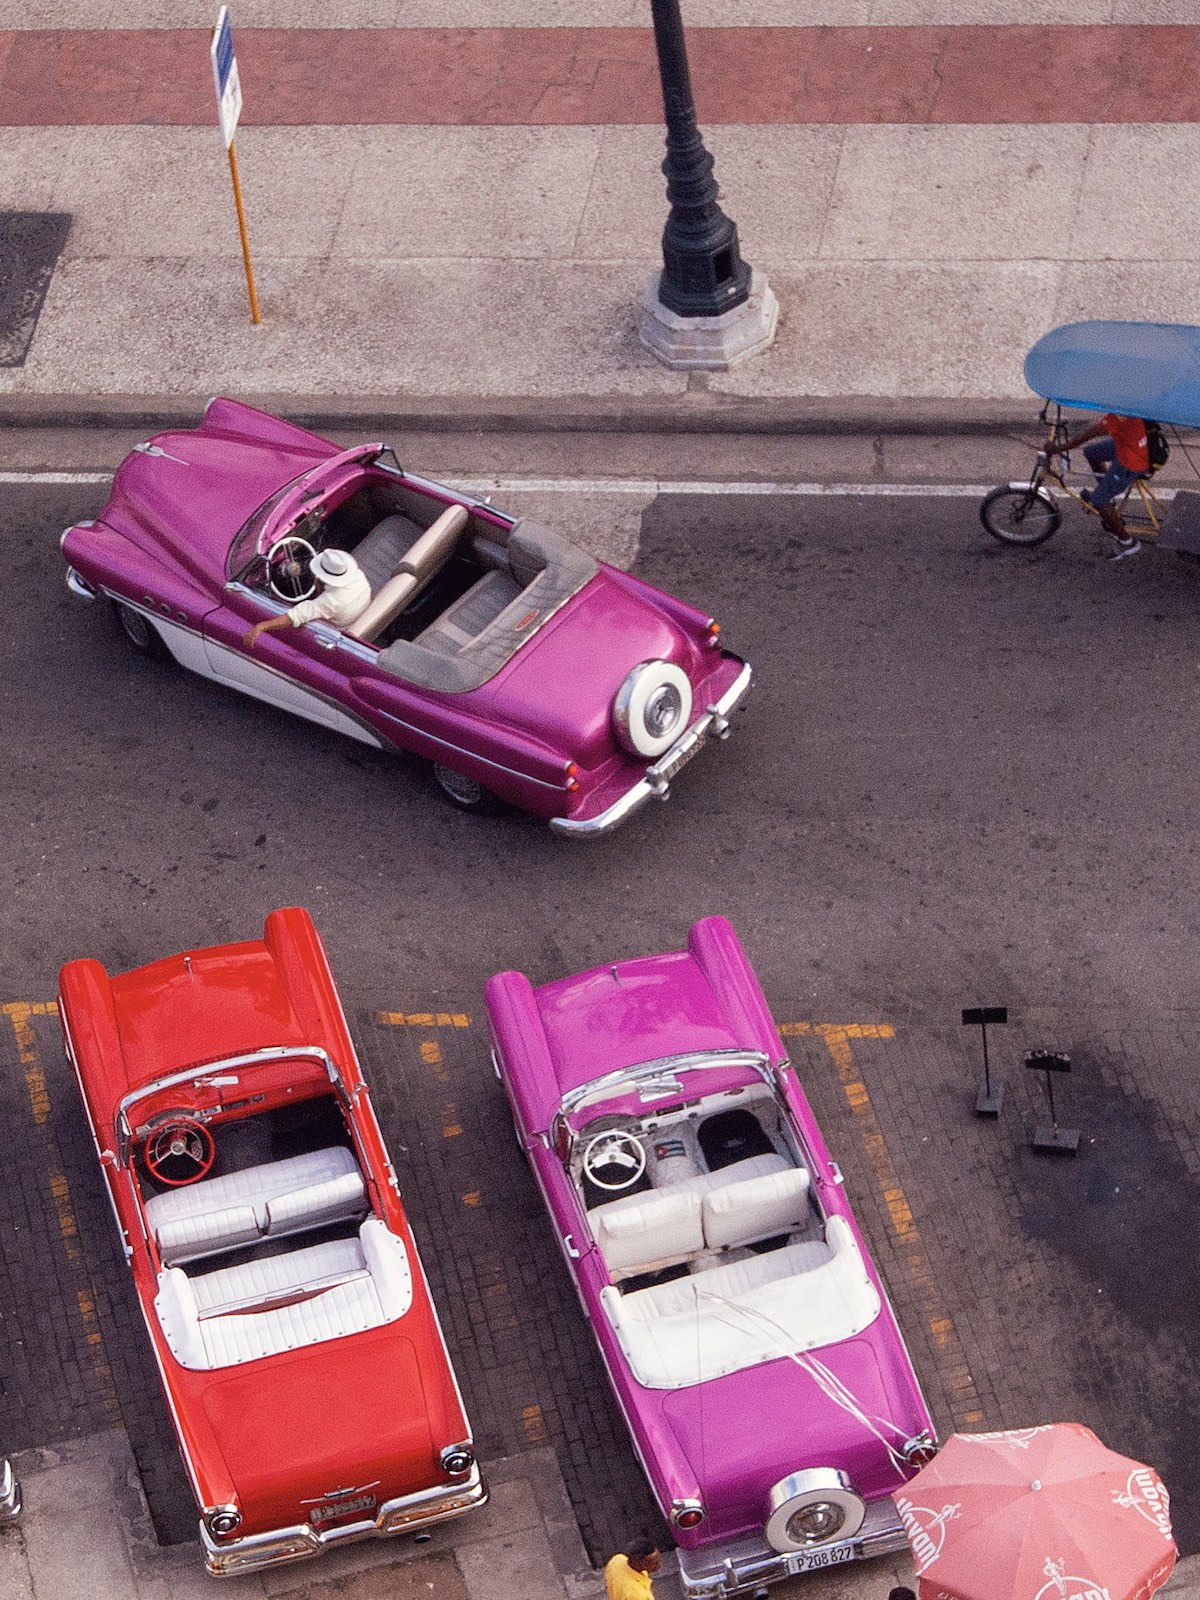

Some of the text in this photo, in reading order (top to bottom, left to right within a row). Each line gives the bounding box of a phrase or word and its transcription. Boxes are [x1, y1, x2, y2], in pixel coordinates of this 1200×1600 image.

[797, 1558, 804, 1570] P
[806, 1552, 829, 1569] 208
[830, 1546, 851, 1562] 827
